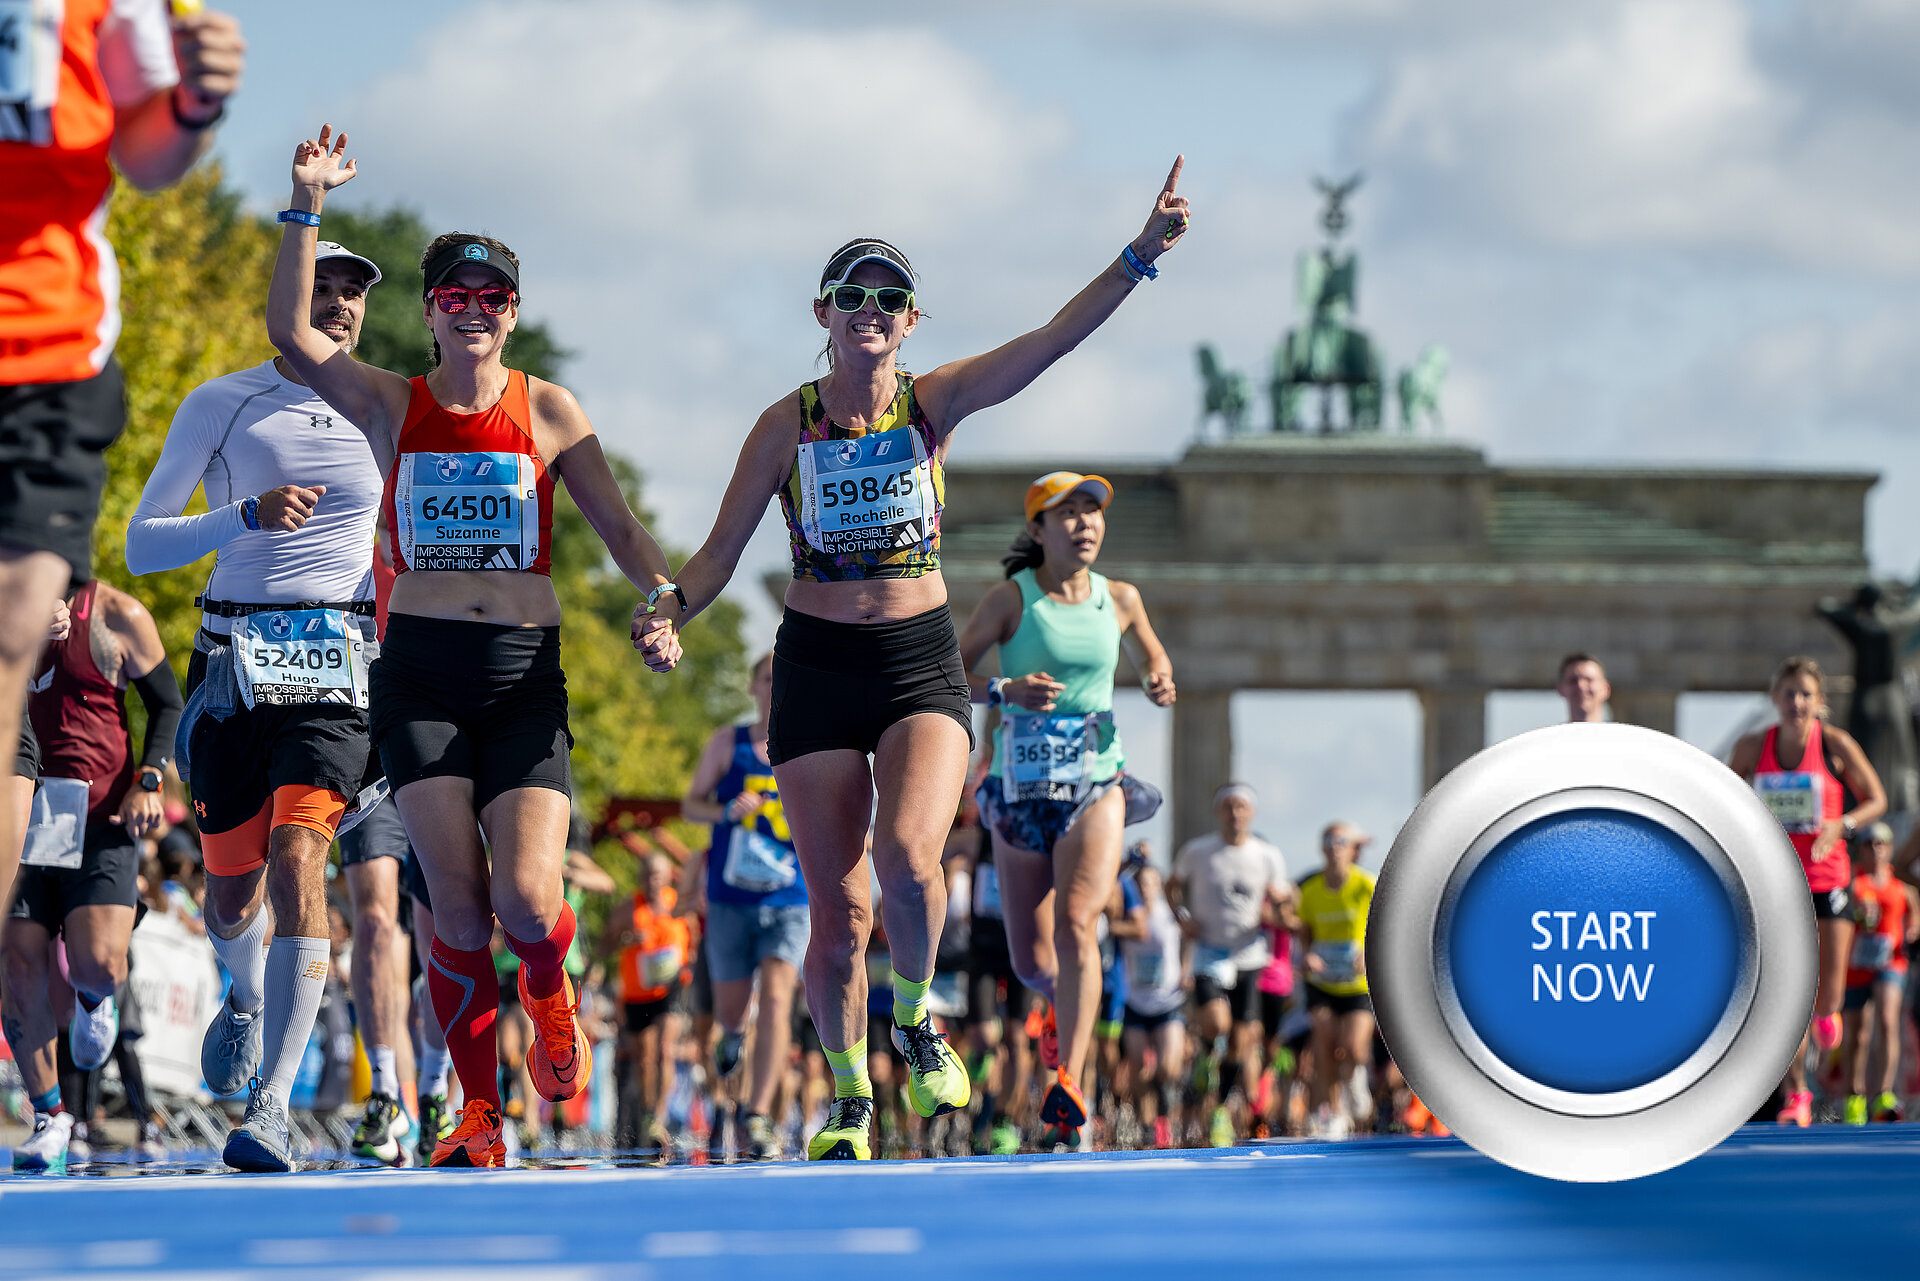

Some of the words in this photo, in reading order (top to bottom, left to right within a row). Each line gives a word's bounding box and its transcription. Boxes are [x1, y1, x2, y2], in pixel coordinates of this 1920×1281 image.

[919, 460, 927, 471] C
[526, 489, 535, 500] C
[822, 470, 914, 508] 59845
[422, 494, 511, 521] 64501
[839, 506, 905, 526] Rochelle
[435, 525, 501, 539] Suzanne
[823, 527, 893, 543] IMPOSSIBLE
[416, 546, 484, 557] IMPOSSIBLE
[825, 544, 836, 554] IS
[838, 538, 892, 553] NOTHING
[416, 558, 426, 569] IS
[428, 558, 481, 569] NOTHING
[354, 642, 361, 652] C
[254, 647, 342, 670] 52409
[281, 673, 320, 685] Hugo
[254, 684, 319, 695] IMPOSSIBLE
[255, 693, 266, 703] IS
[267, 693, 318, 704] NOTHING
[1016, 744, 1078, 763] 36593
